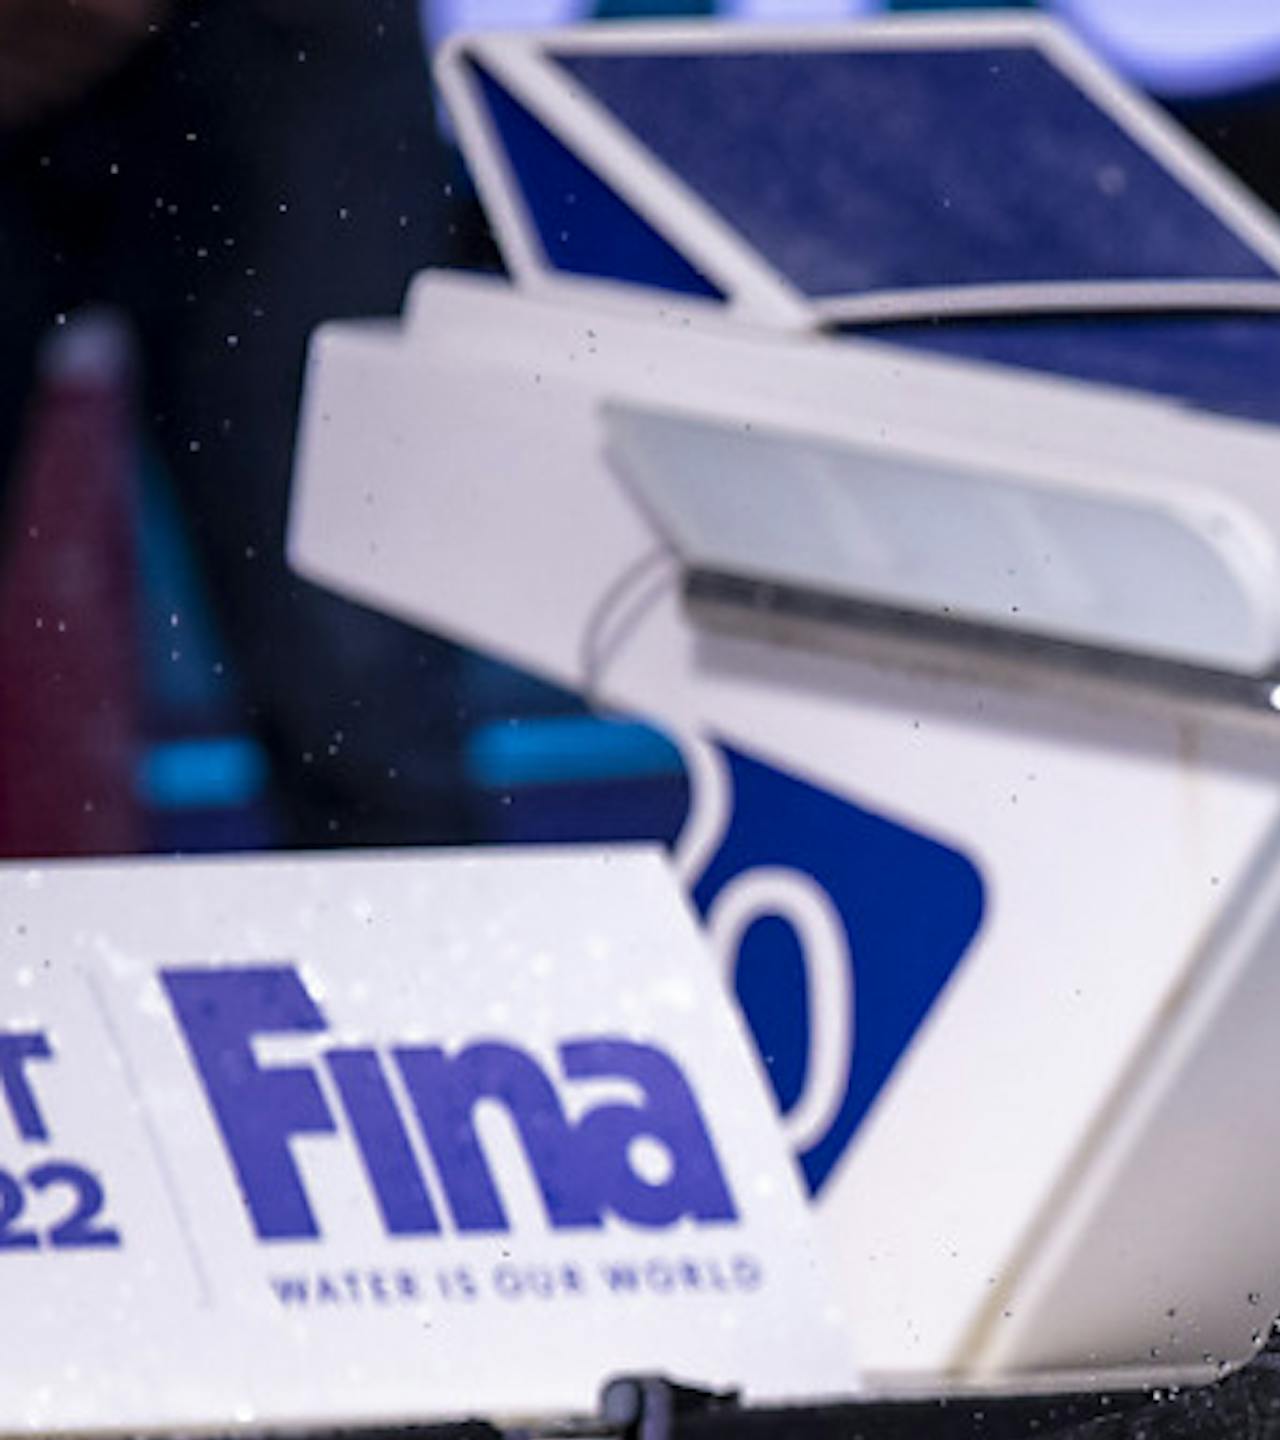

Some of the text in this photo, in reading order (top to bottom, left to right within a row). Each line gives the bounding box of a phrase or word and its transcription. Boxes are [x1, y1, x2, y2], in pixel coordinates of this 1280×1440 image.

[158, 963, 741, 1240] Fina
[271, 1256, 763, 1306] WATER IS OUR WORLD
